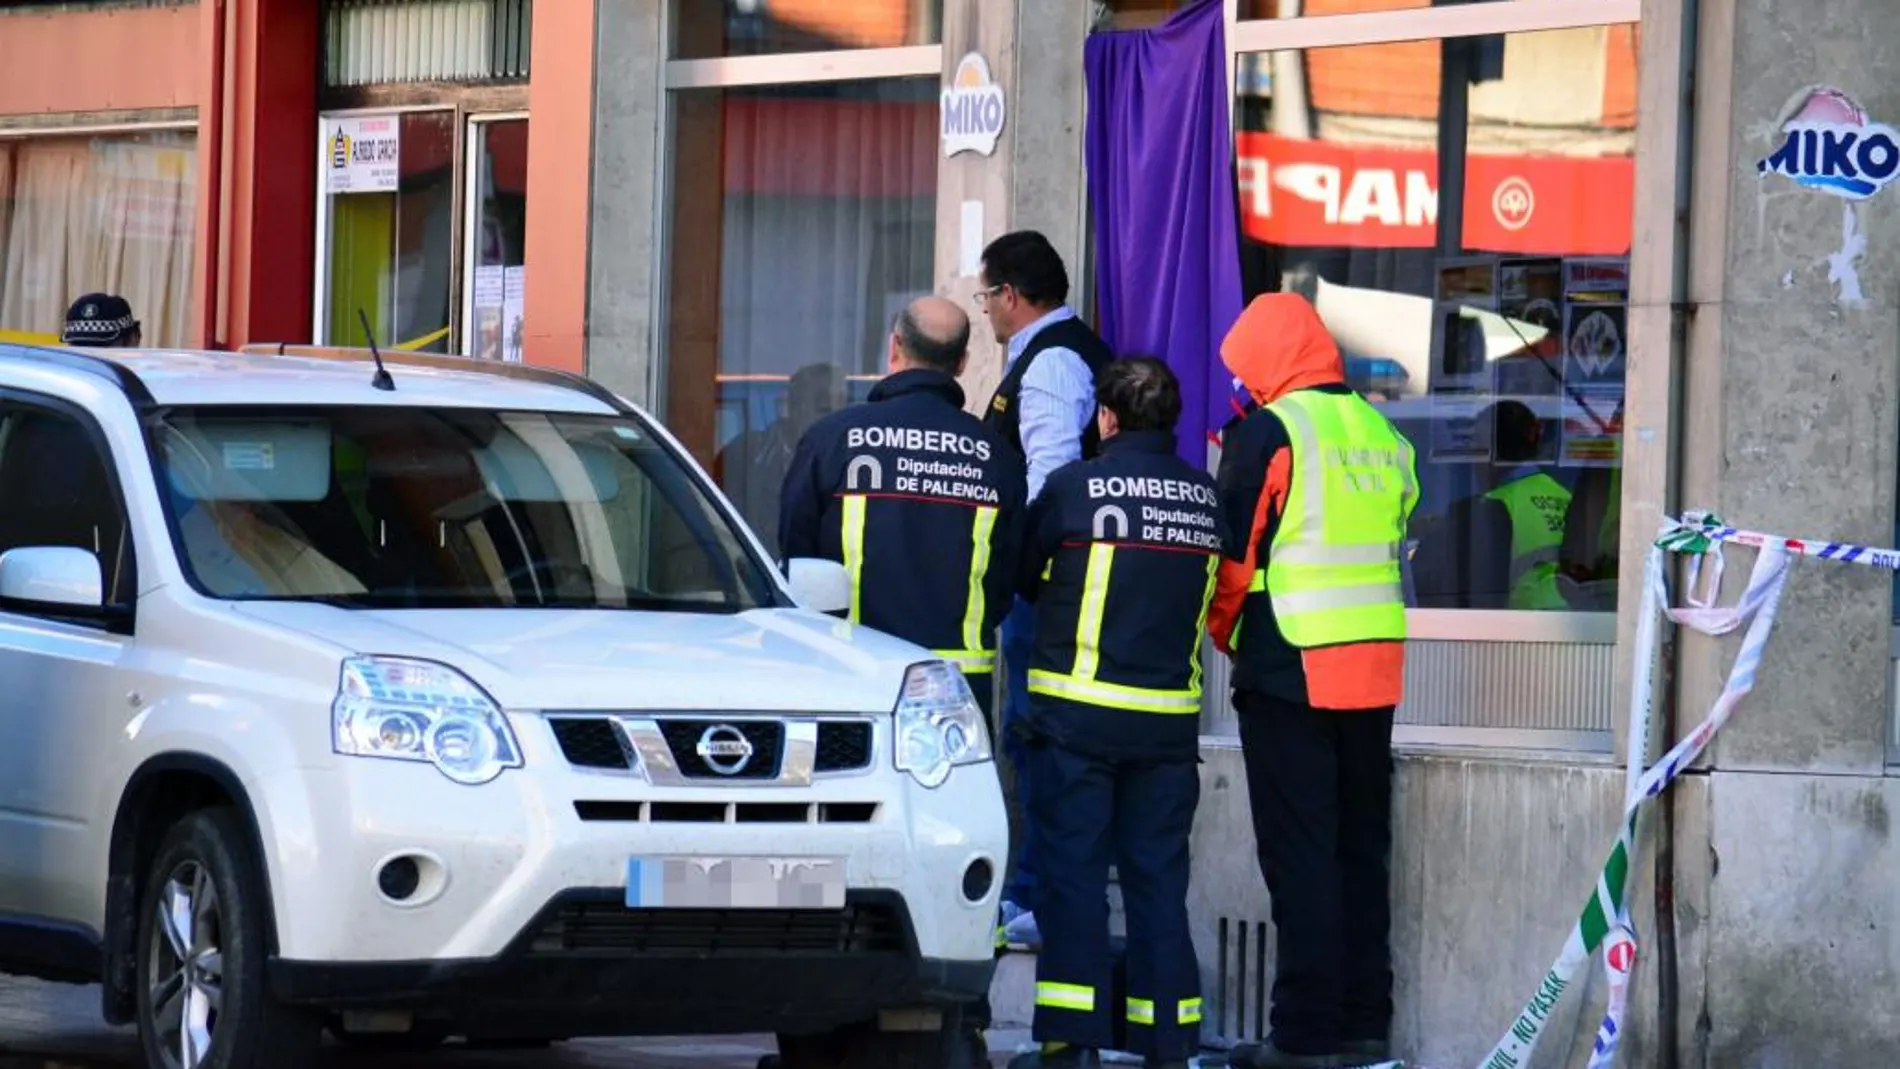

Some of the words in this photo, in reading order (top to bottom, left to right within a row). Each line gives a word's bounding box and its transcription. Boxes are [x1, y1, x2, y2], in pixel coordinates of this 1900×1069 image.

[944, 93, 1001, 136] MIKO
[847, 427, 991, 461] BOMBEROS
[896, 457, 982, 480] Diputación
[895, 477, 919, 492] DE
[922, 479, 999, 502] PALENCIA
[1088, 477, 1217, 507] BOMBEROS
[1141, 505, 1214, 528] Diputación
[1141, 525, 1163, 541] DE
[1512, 1015, 1537, 1044] NO
[1527, 970, 1569, 1020] PASAR
